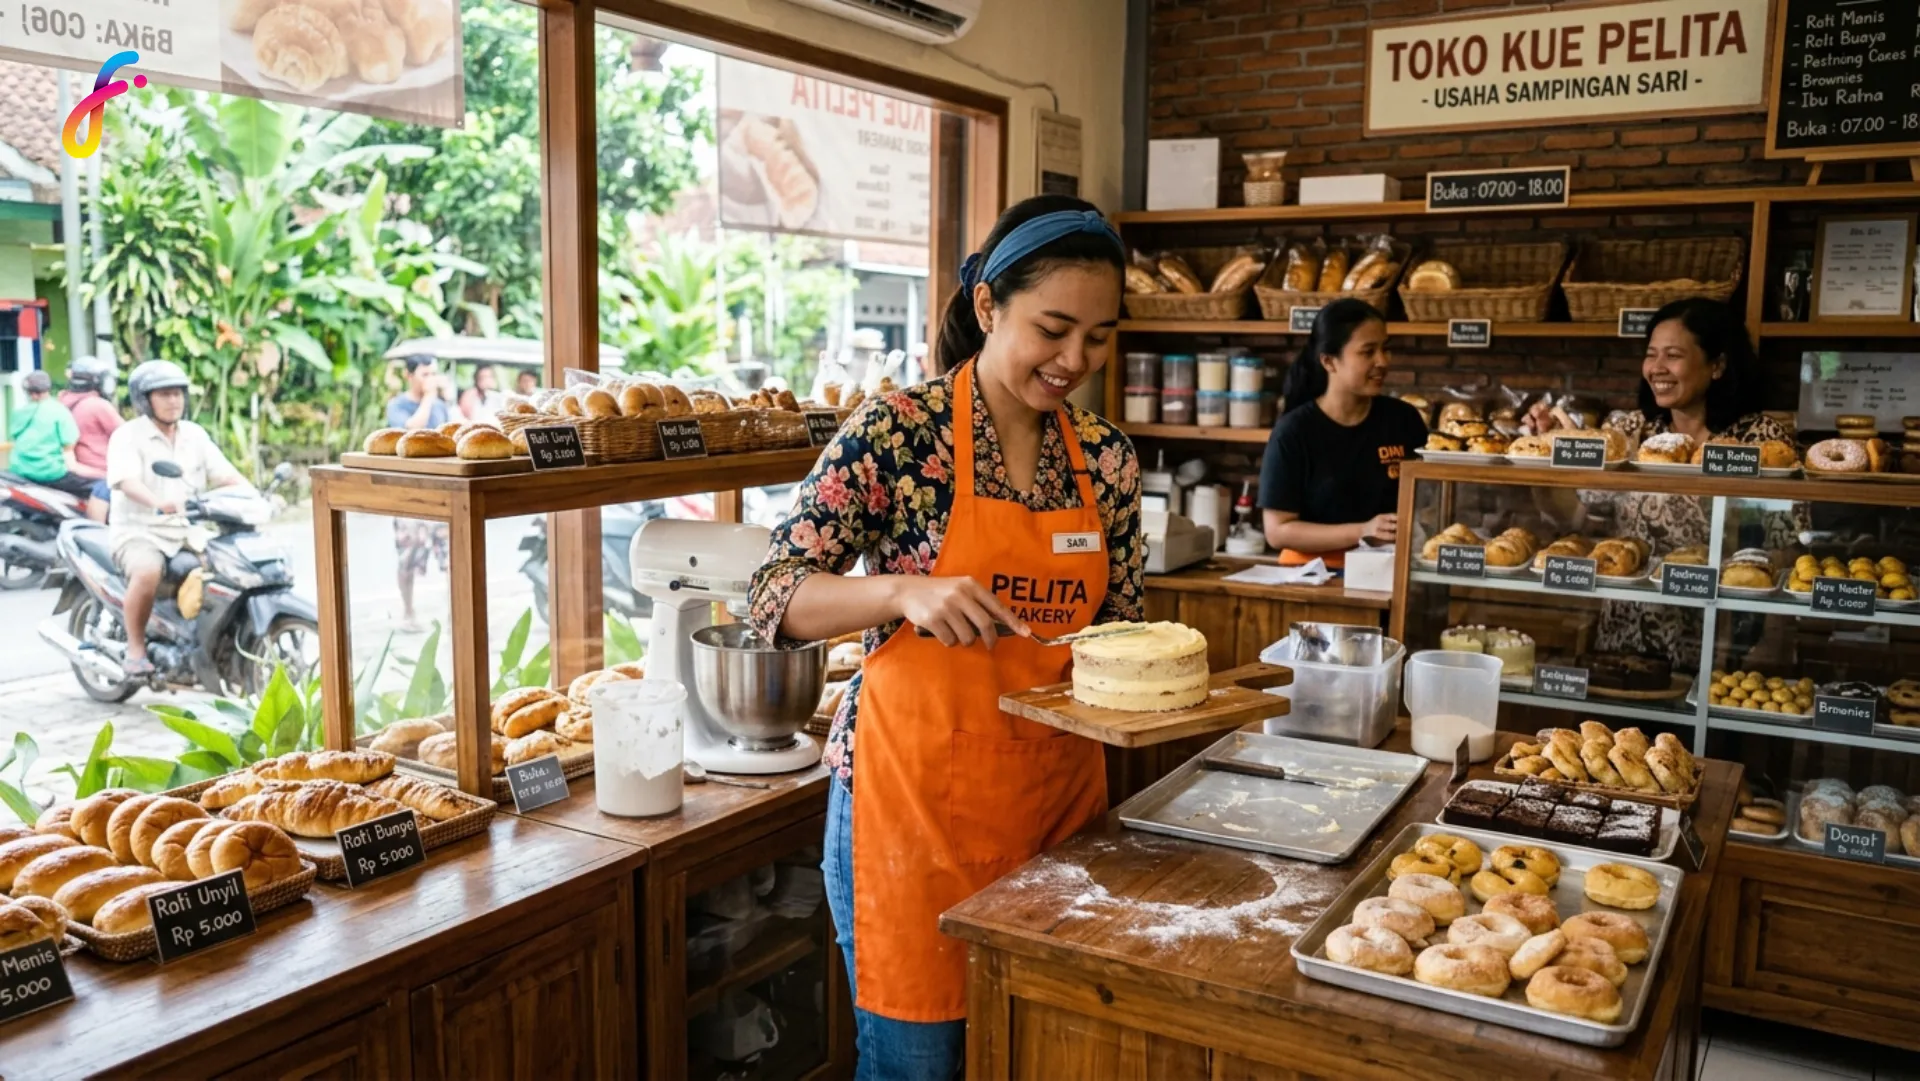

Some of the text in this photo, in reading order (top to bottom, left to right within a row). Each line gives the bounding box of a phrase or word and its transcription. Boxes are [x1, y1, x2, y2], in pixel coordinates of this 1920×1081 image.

[1386, 10, 1748, 82] TOKO KUE PELITA
[1840, 30, 1886, 48] Buaya
[1434, 84, 1499, 108] USAHA
[1505, 74, 1630, 103] SAMPINGAN
[1637, 69, 1688, 94] SARI
[1802, 72, 1863, 88] Brownies
[1801, 92, 1828, 108] Ibu
[1787, 121, 1827, 138] Buka
[1433, 182, 1468, 200] Buka
[992, 573, 1088, 605] PELITA
[1011, 606, 1077, 624] AKERY
[343, 829, 372, 850] Roti
[1830, 827, 1879, 847] Donat
[358, 857, 376, 875] Rp
[155, 877, 240, 919] Roti Unyil
[171, 910, 242, 947] Rp 5.000
[2, 947, 56, 977] Manis
[0, 976, 52, 1006] 5.000
